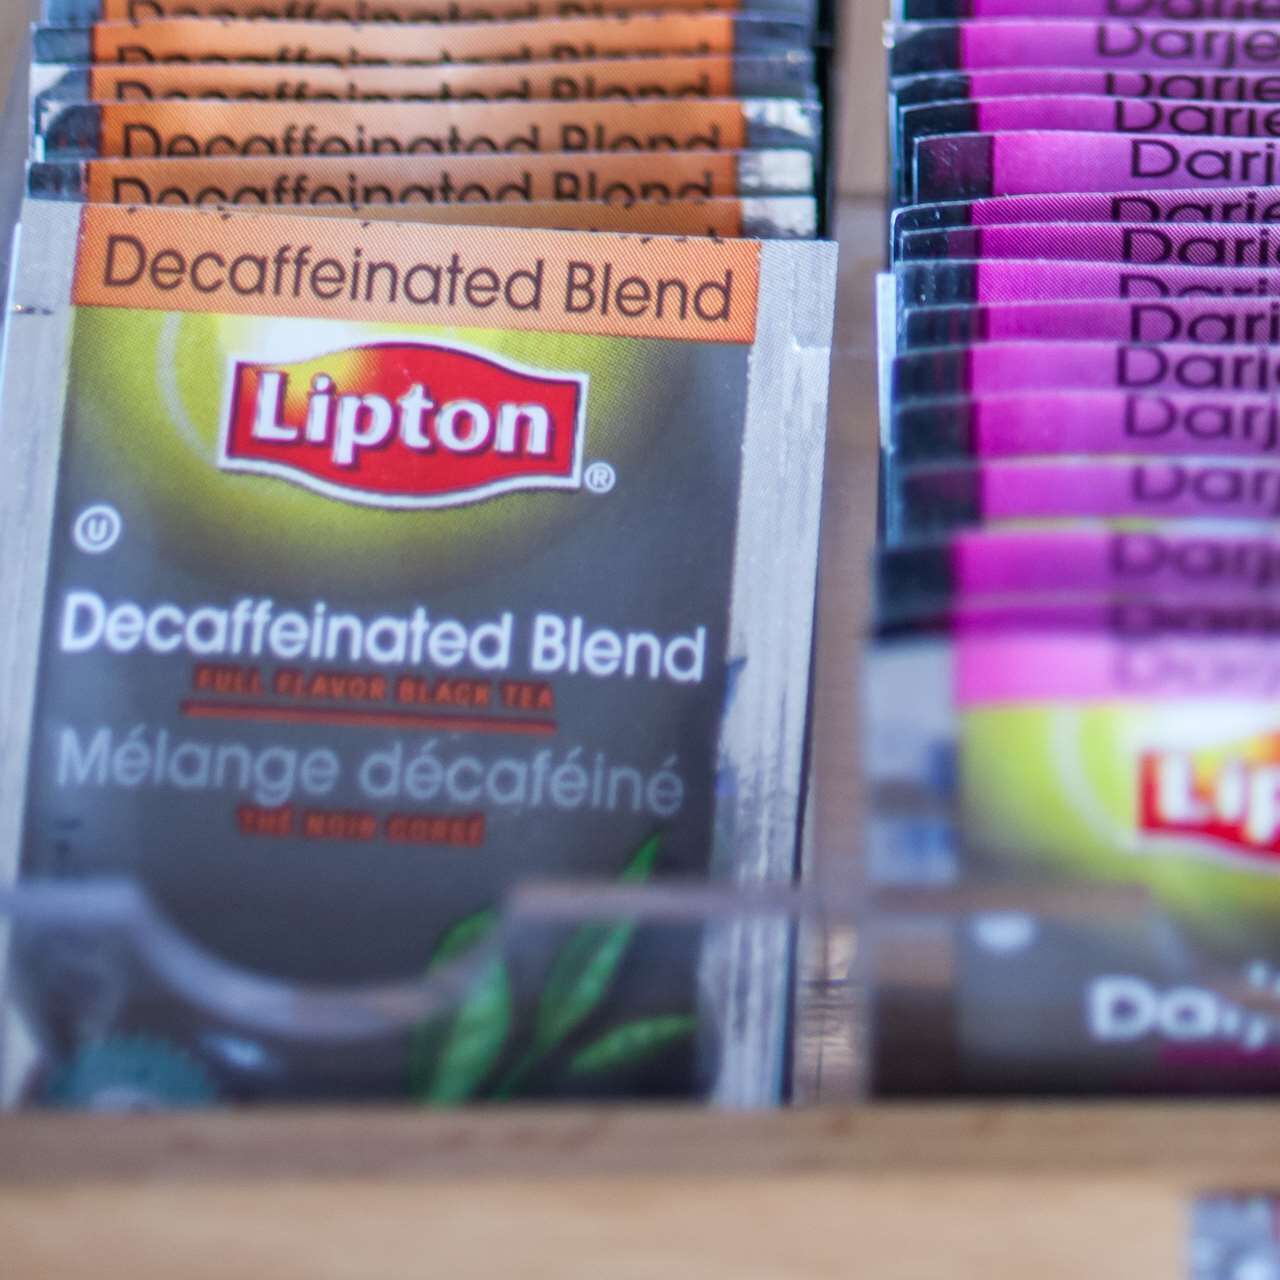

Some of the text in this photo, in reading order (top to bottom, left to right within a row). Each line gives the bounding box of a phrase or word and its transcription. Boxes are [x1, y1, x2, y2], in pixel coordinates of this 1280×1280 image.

[103, 233, 734, 324] Decaffeinated Blend
[252, 371, 552, 467] Lipton
[59, 591, 707, 683] Decaffeinated Blend
[194, 664, 554, 710] FULL FLAVOR BLACK TEA
[54, 723, 685, 817] Mélange décaféiné
